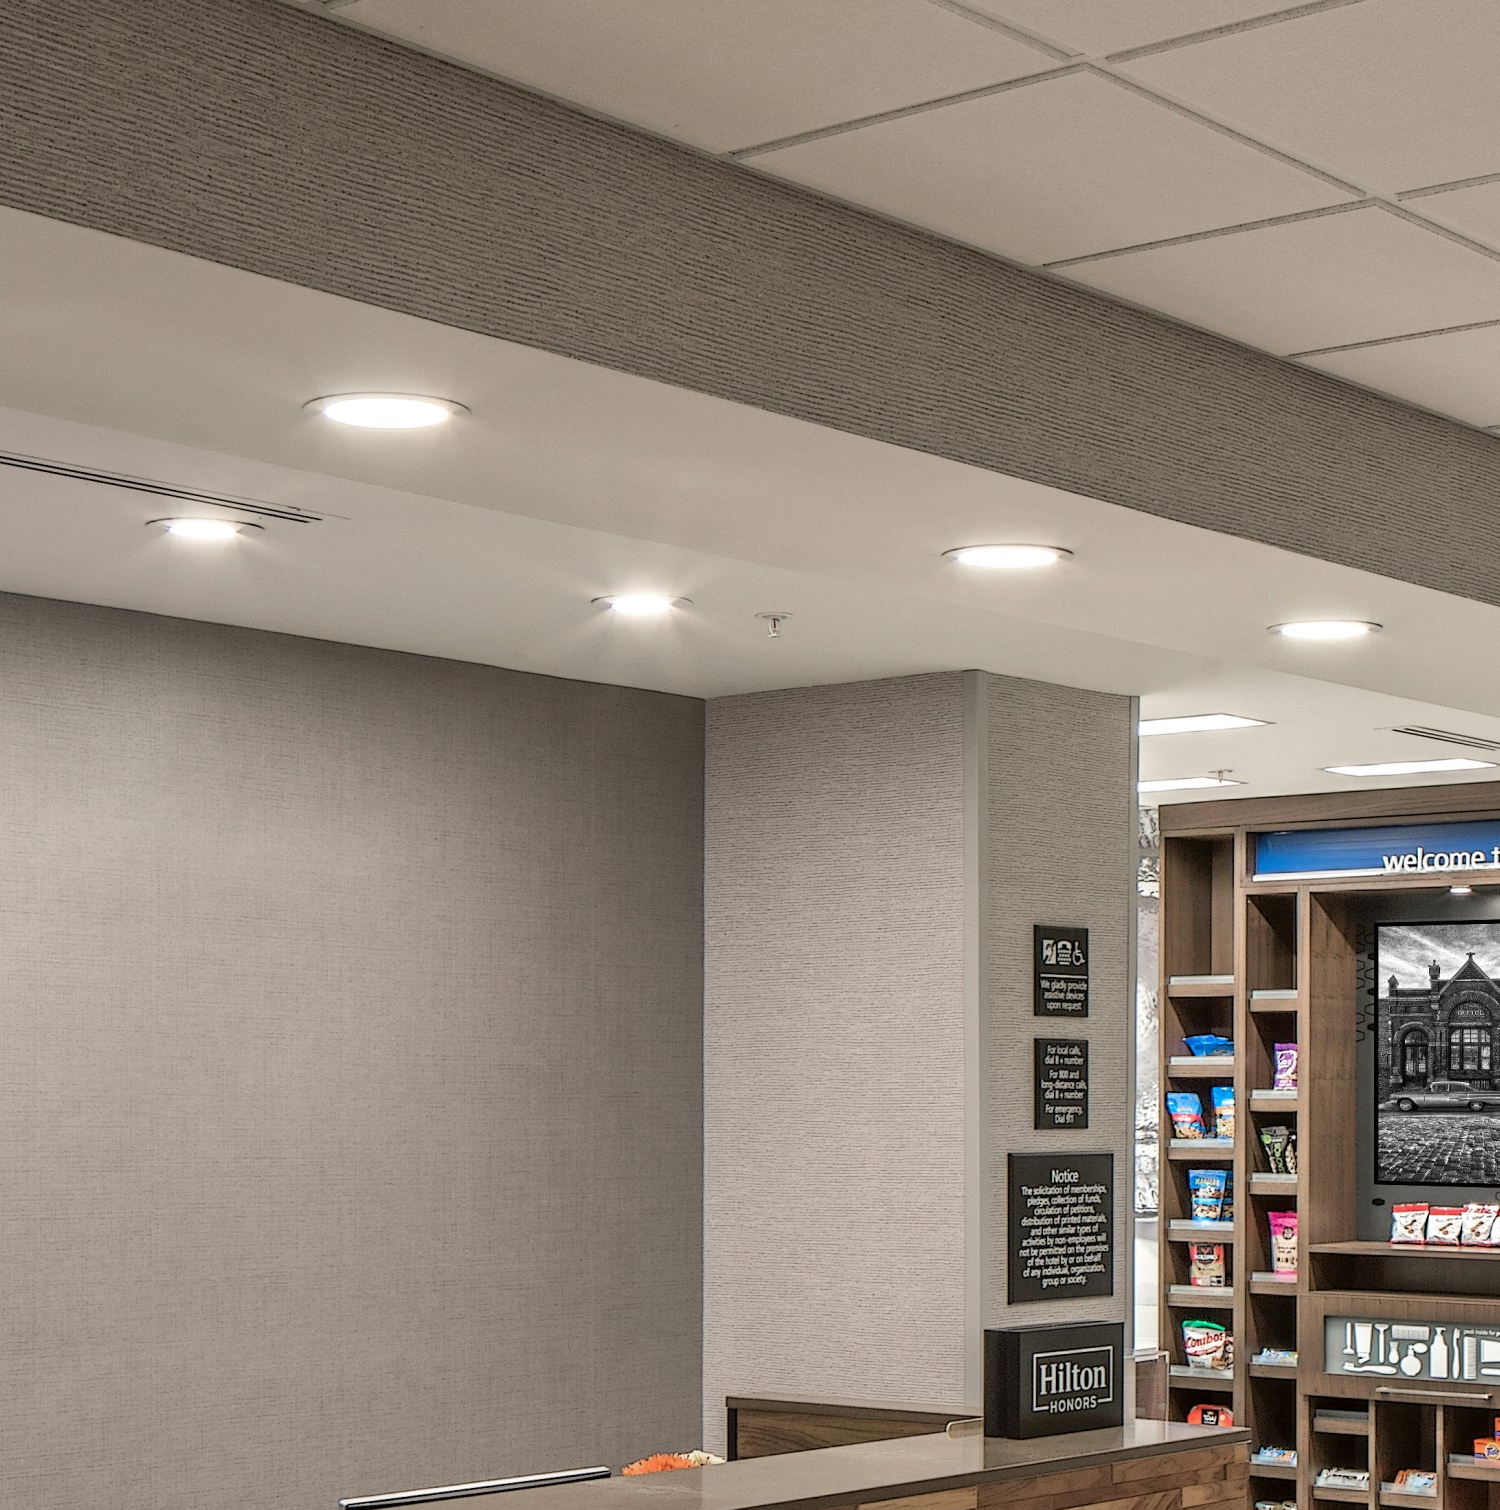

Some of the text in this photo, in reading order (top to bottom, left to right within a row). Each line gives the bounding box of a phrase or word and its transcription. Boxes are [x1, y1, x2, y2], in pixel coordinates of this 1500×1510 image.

[1382, 847, 1486, 873] welcome
[1040, 979, 1087, 993] We gladly provide
[1043, 990, 1085, 1000] assistive devices
[1046, 1002, 1061, 1012] upon
[1047, 1044, 1057, 1055] For
[1057, 1045, 1069, 1055] local
[1044, 1055, 1054, 1065] dial
[1064, 1056, 1084, 1065] number
[1049, 1069, 1059, 1079] For
[1069, 1070, 1079, 1079] and
[1041, 1079, 1075, 1091] long-distance
[1044, 1089, 1054, 1099] dial
[1064, 1090, 1084, 1099] number
[1045, 1104, 1054, 1114] For
[1055, 1114, 1065, 1124] Dial
[1051, 1168, 1079, 1183] Notice
[1021, 1183, 1107, 1196] The solicitation of memberships,
[1027, 1193, 1102, 1208] pledges, collection of funds,
[1034, 1204, 1096, 1216] circulation of petitions,
[1021, 1213, 1108, 1228] distribution of printed materials,
[1030, 1223, 1099, 1236] and other similar types of
[1022, 1232, 1107, 1247] activities by non-employees will
[1019, 1243, 1109, 1257] not be permitted on the premises
[1027, 1257, 1034, 1266] of
[1035, 1256, 1045, 1266] the
[1045, 1255, 1060, 1265] hotel
[1061, 1255, 1068, 1266] by
[1068, 1256, 1075, 1264] or
[1084, 1252, 1102, 1263] behalf
[1023, 1263, 1105, 1279] of any individual, organization,
[1042, 1278, 1059, 1288] group
[1067, 1275, 1087, 1286] society.
[1185, 1331, 1224, 1349] Combos
[1040, 1362, 1107, 1395] Hilton
[1050, 1395, 1097, 1414] HONORS
[1486, 1447, 1499, 1456] Tide
